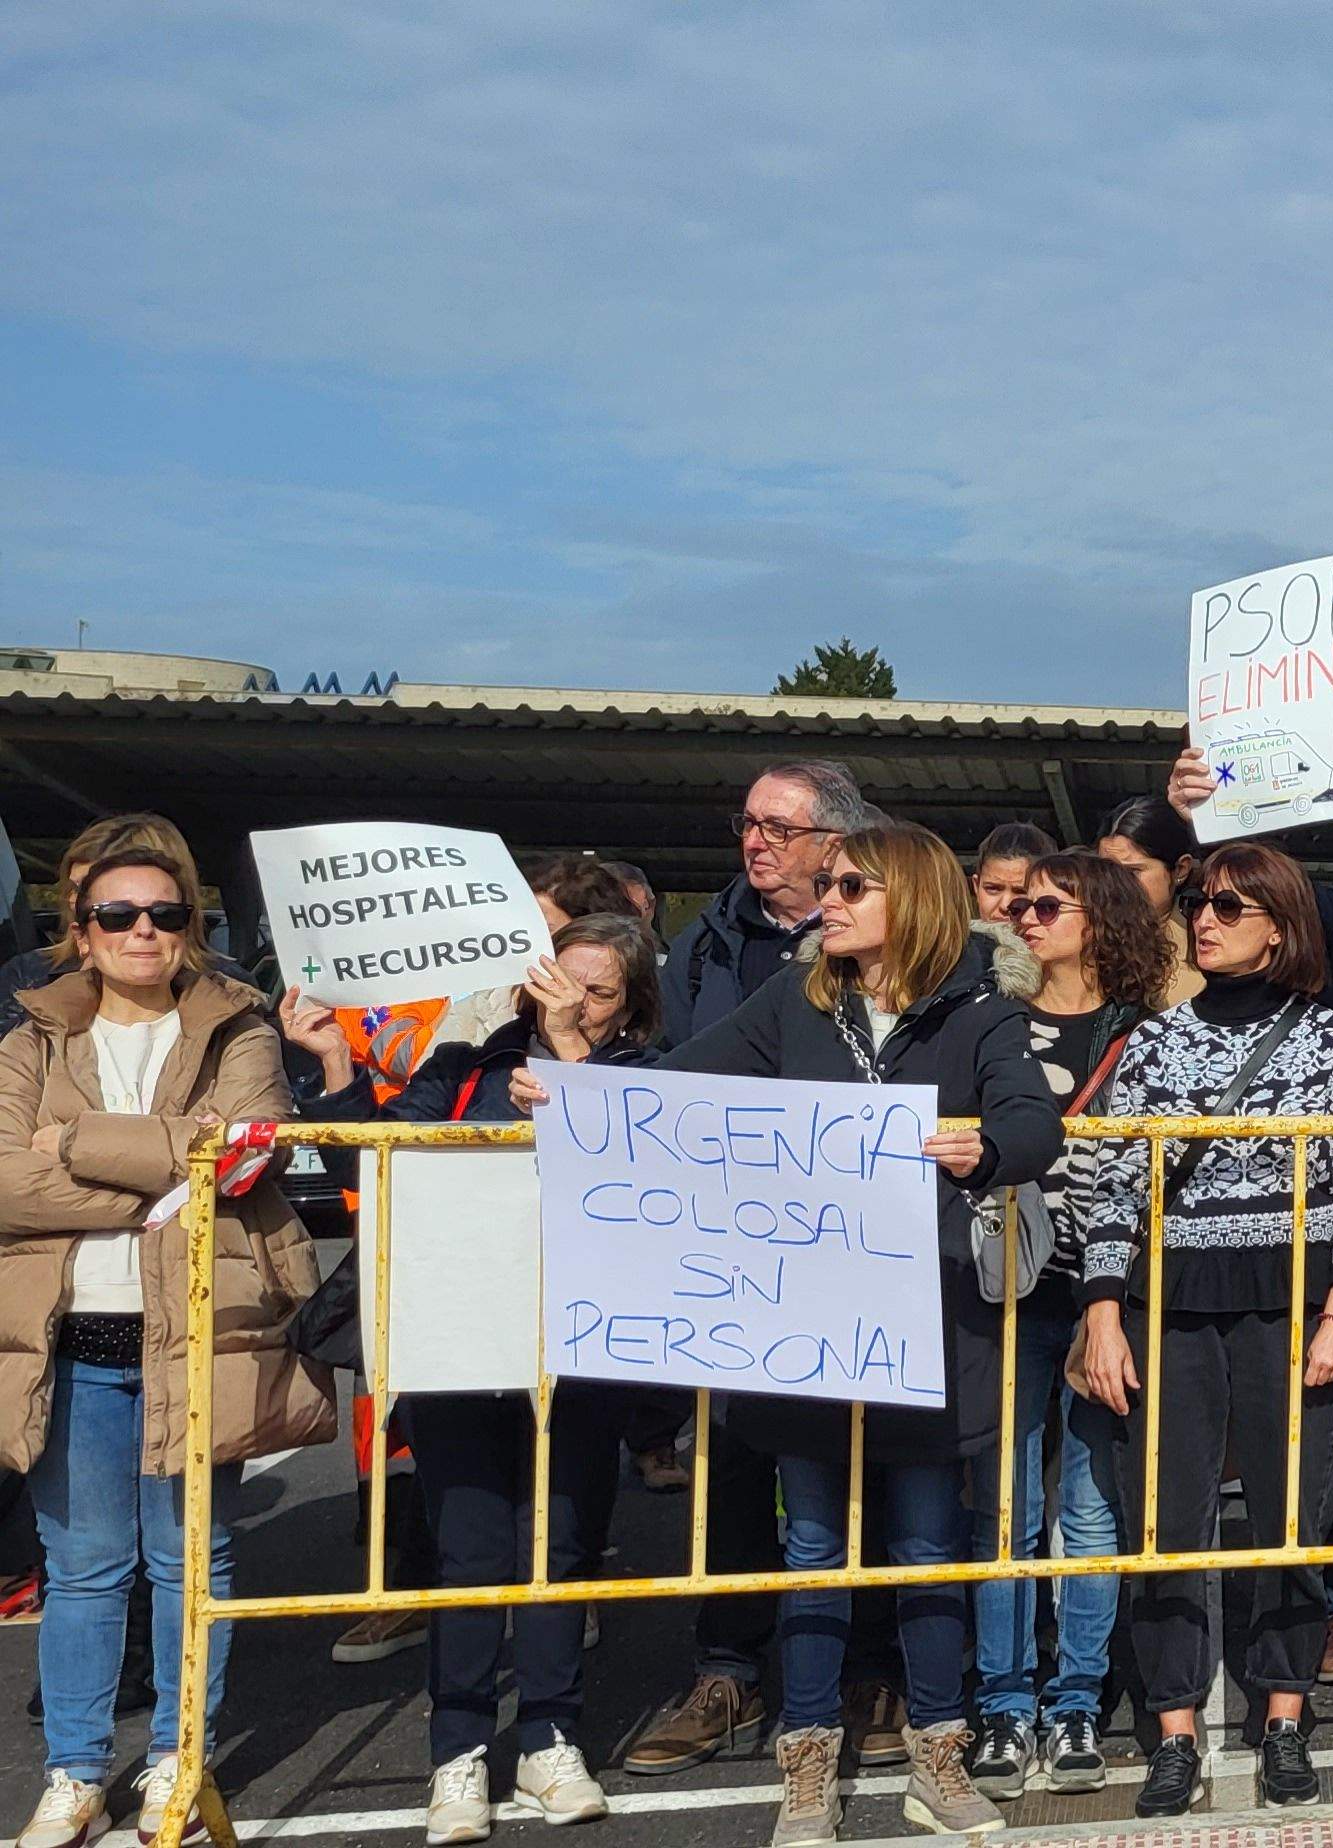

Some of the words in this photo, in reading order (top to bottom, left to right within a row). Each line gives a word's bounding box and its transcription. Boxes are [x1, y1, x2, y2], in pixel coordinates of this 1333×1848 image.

[300, 847, 467, 884] MEJORES
[288, 883, 508, 929] HOSPITALES
[334, 929, 533, 982] RECURSOS
[583, 1182, 914, 1258] COLOSAL
[564, 1300, 944, 1395] PERSONAL
